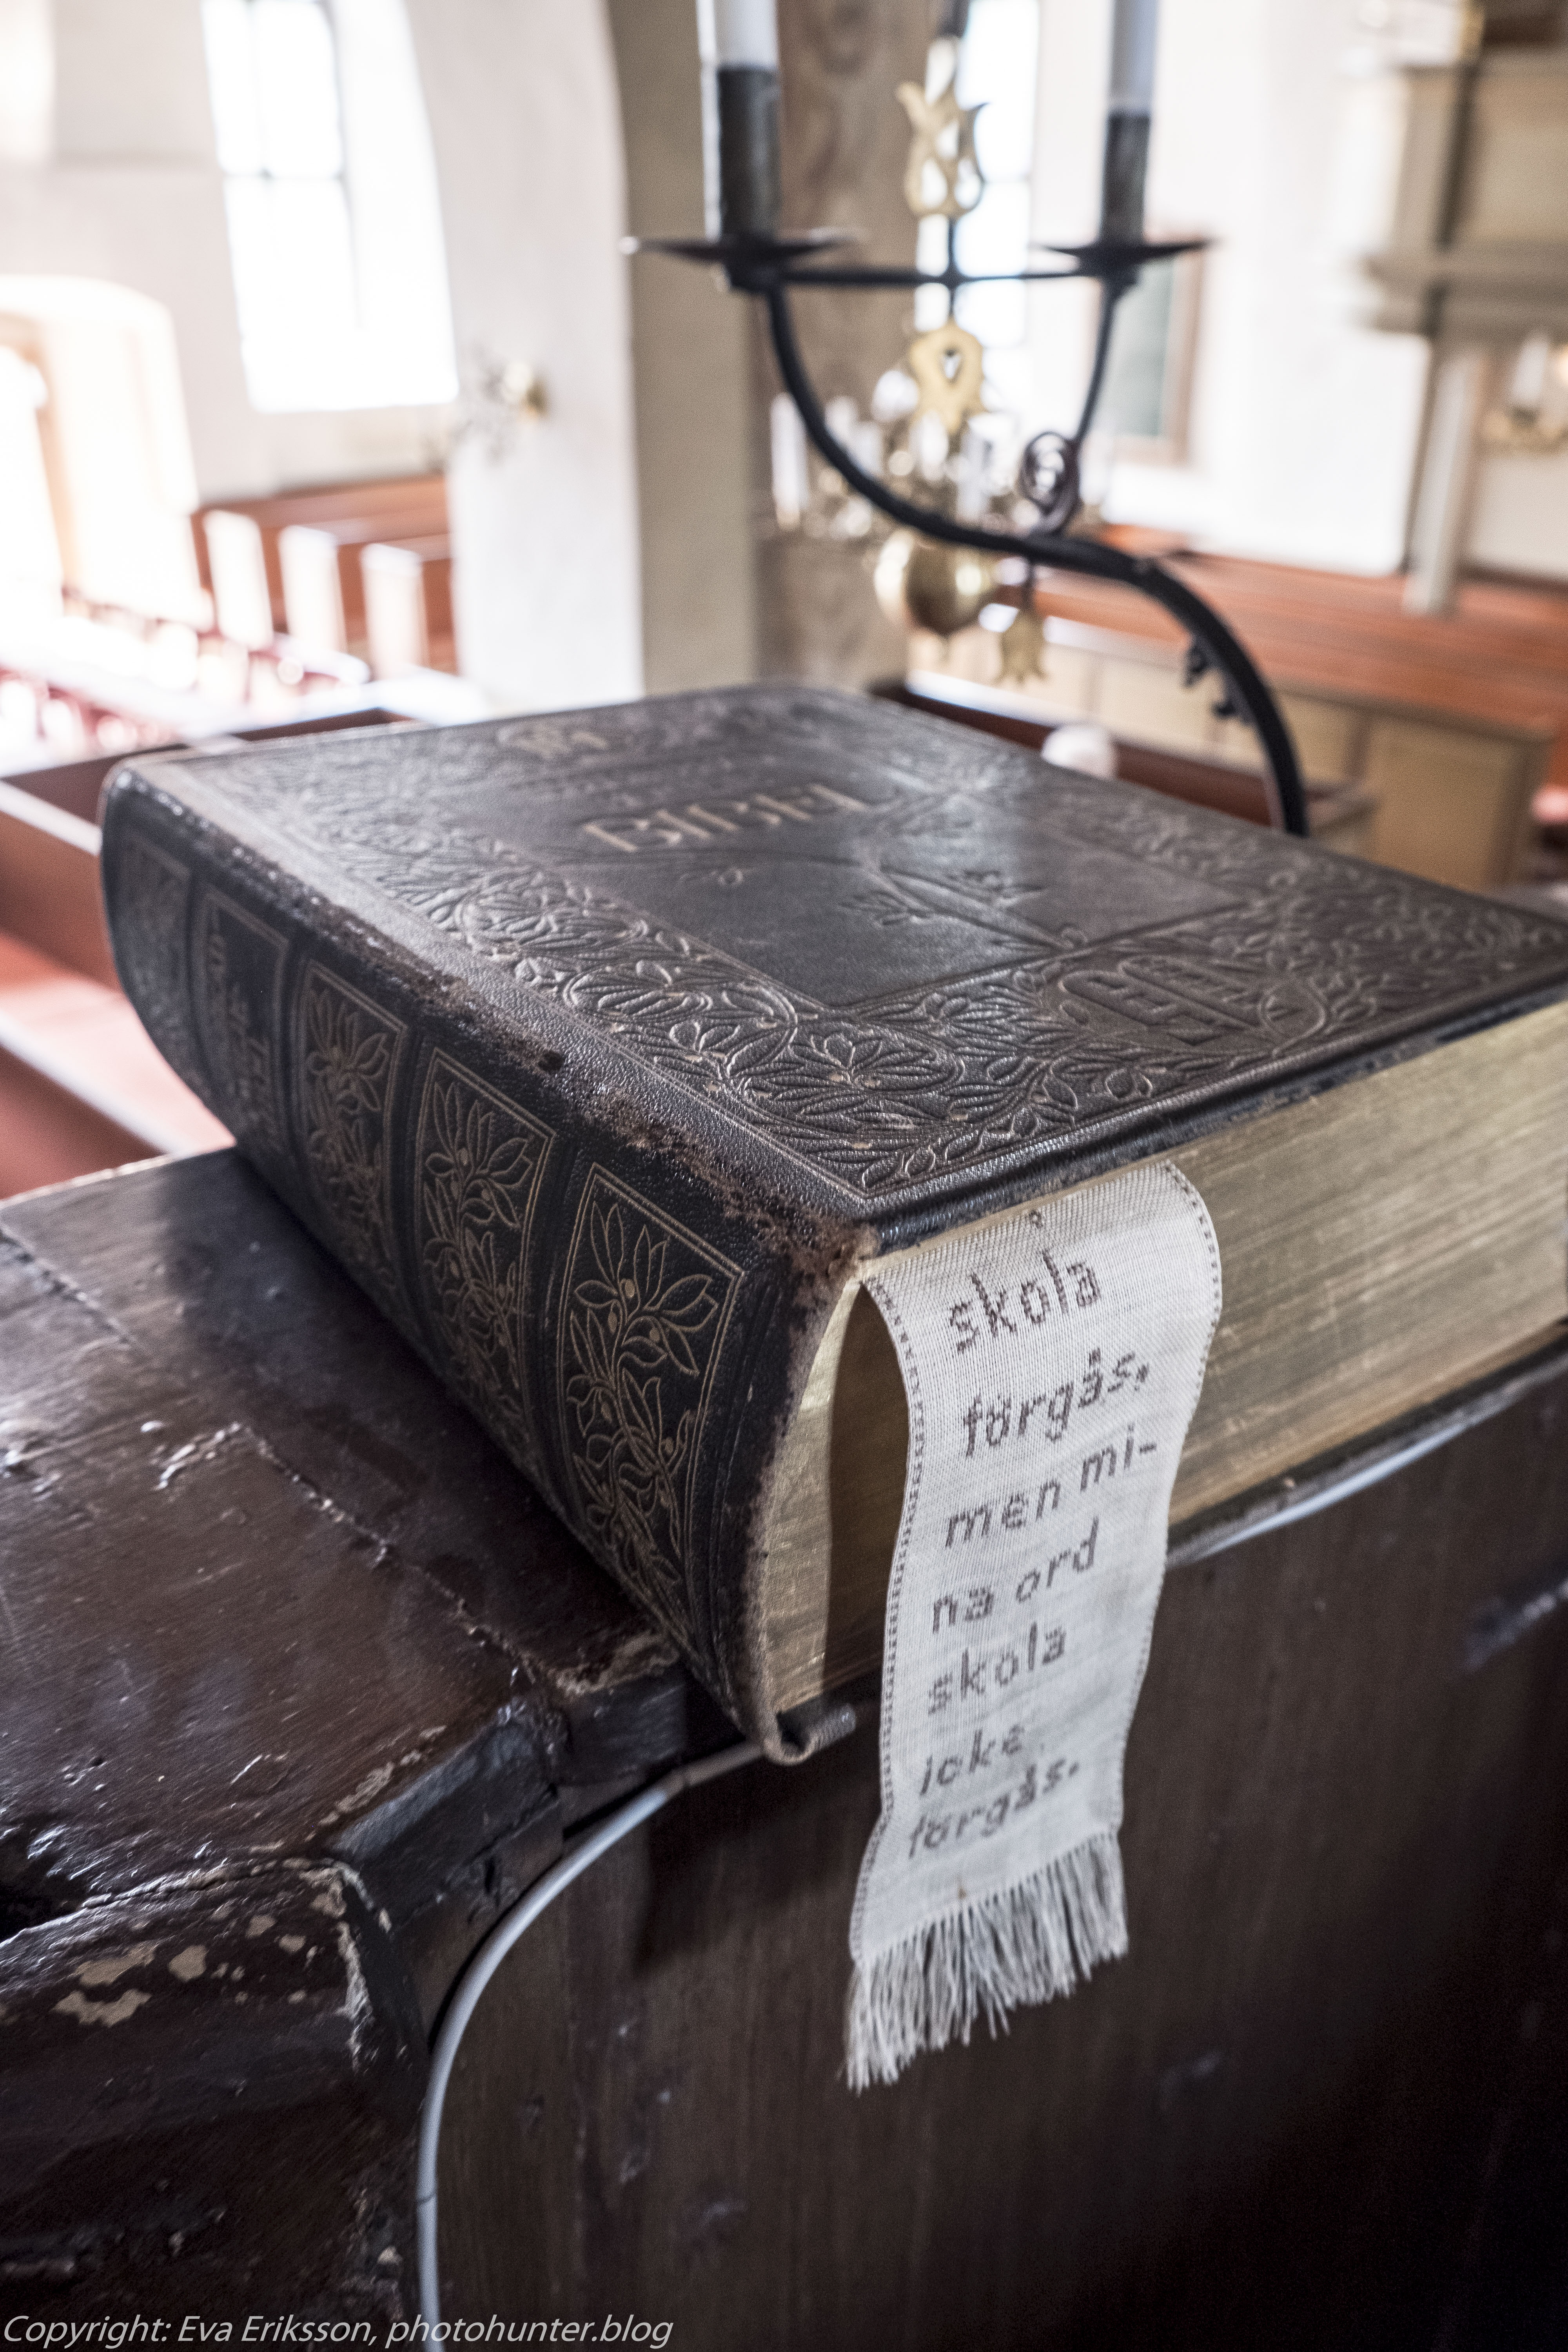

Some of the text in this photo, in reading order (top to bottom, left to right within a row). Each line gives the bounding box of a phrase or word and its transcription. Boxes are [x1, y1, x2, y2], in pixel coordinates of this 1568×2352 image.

[949, 1250, 1100, 1353] skola
[945, 1423, 1158, 1548] men mi-
[932, 1516, 1098, 1634] na ord
[928, 1621, 1067, 1715] skola
